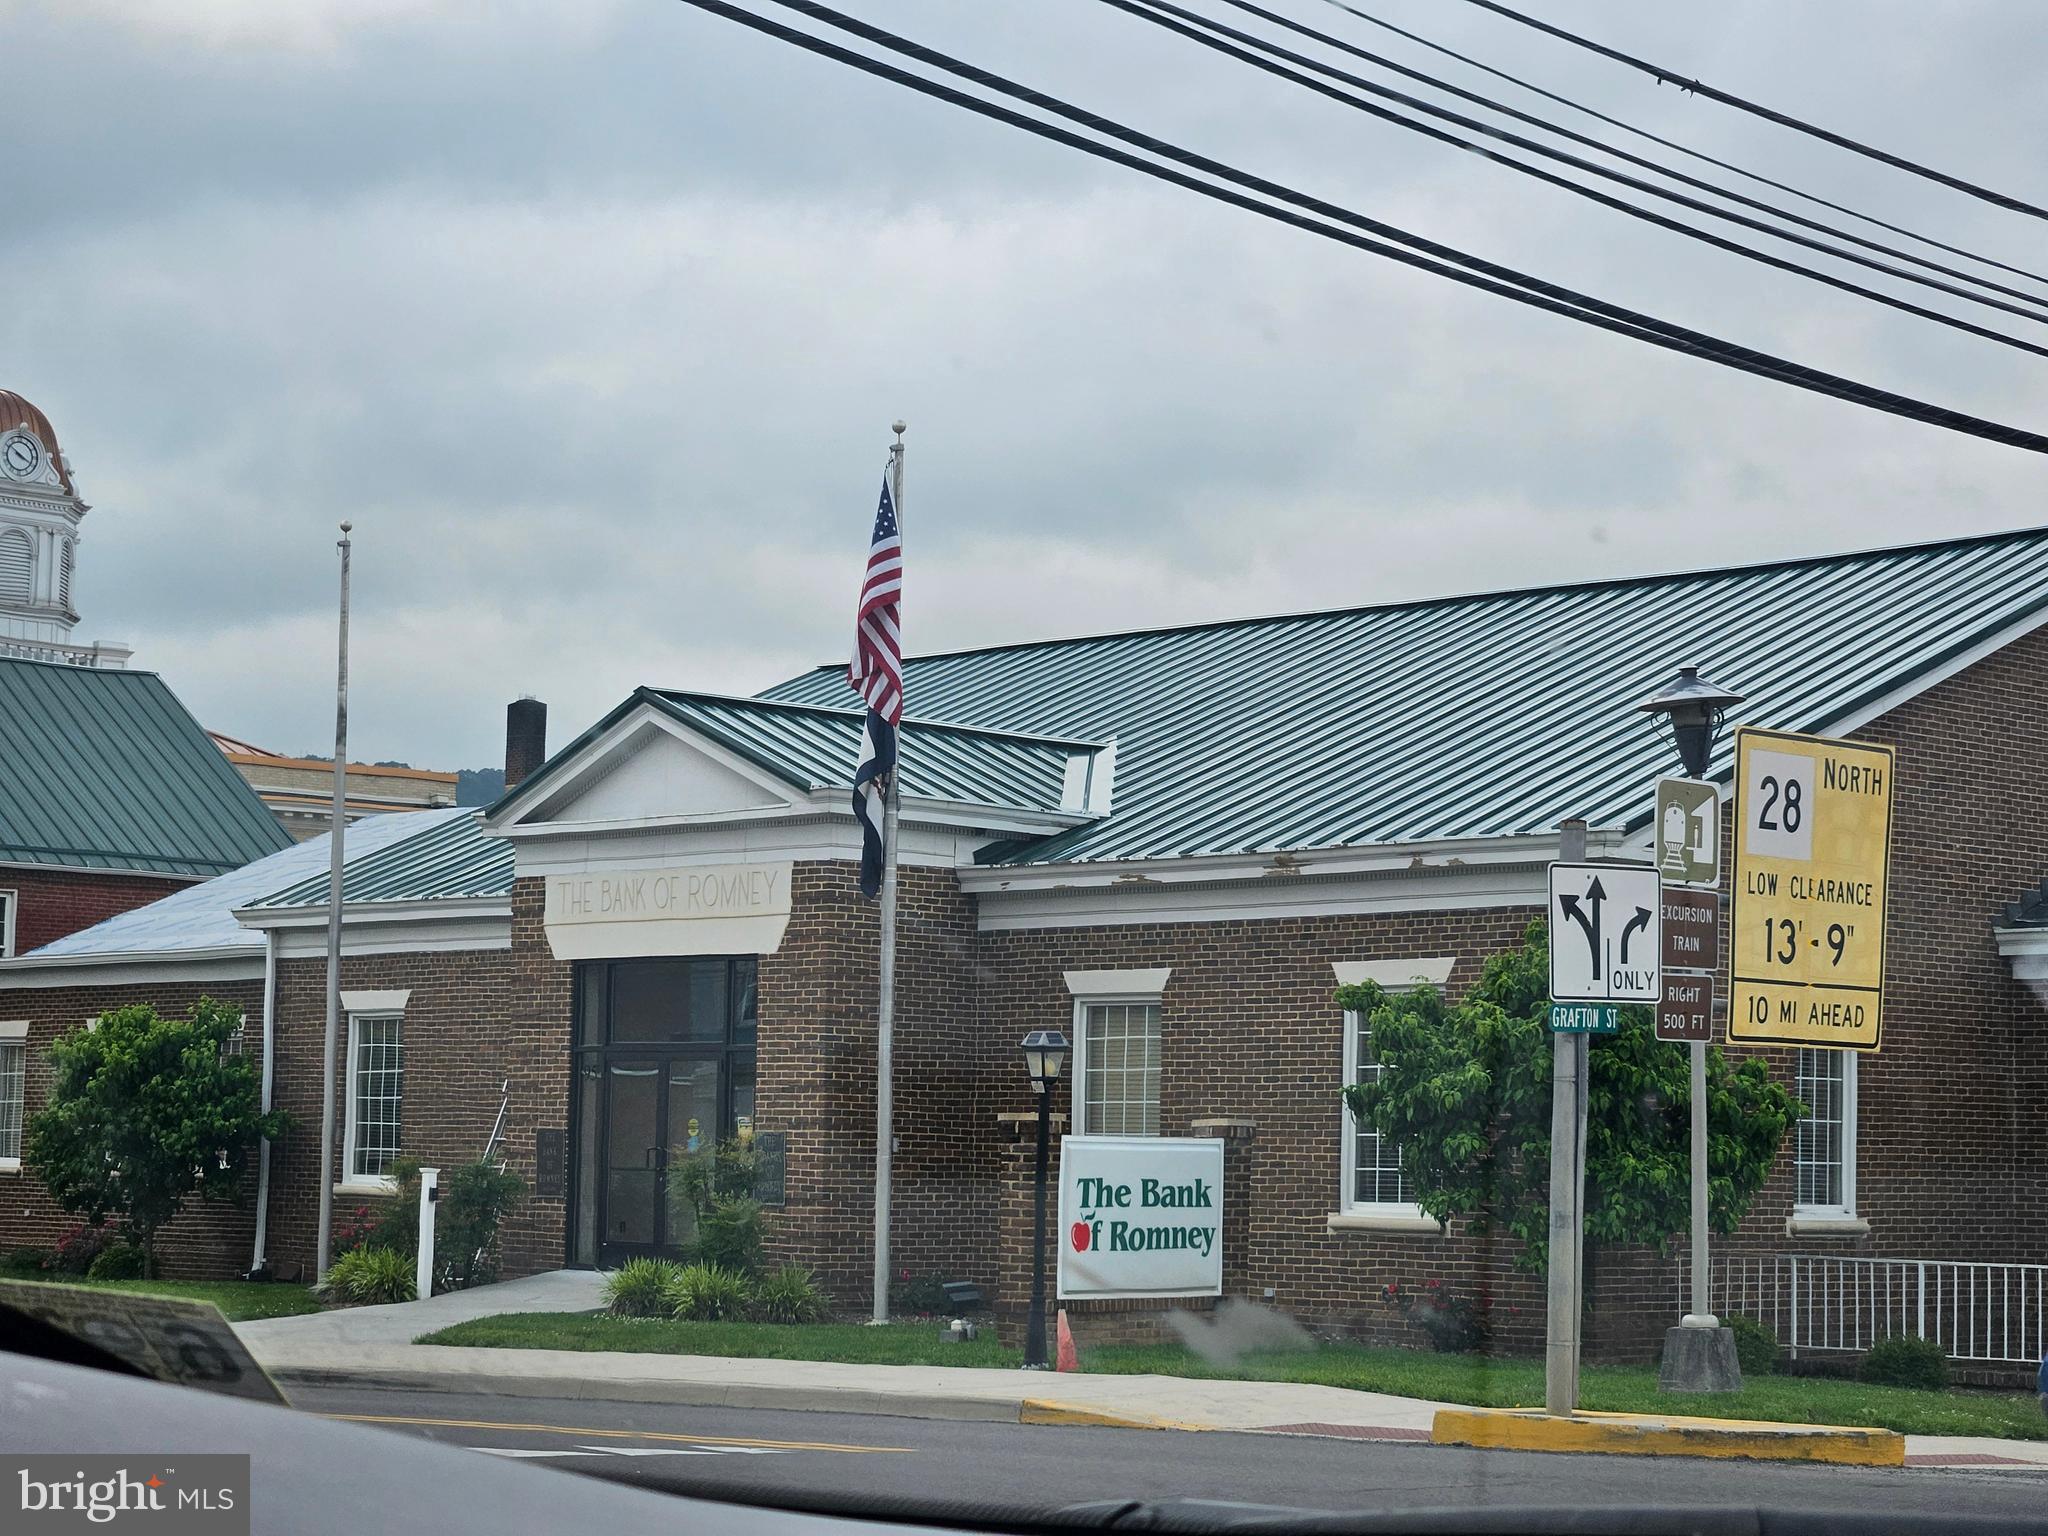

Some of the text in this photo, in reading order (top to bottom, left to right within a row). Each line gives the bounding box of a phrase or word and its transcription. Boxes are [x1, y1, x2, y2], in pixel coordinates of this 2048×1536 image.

[1824, 757, 1882, 796] NORTH
[1758, 775, 1802, 834] 28
[558, 871, 778, 914] THE BANK OF ROMNEY
[1747, 871, 1873, 906] LOW CLEARANCE
[1661, 904, 1713, 924] EXCURSION
[1672, 935, 1700, 952] TRAIN
[1613, 970, 1655, 991] ONLY
[1668, 986, 1701, 1003] RIGHT
[1552, 1006, 1618, 1029] GRAFTON ST
[1663, 1013, 1705, 1031] 500 FT
[1748, 996, 1865, 1028] 10 MI AHEAD
[1076, 1177, 1212, 1209] The Bank
[1109, 1220, 1217, 1258] Romney
